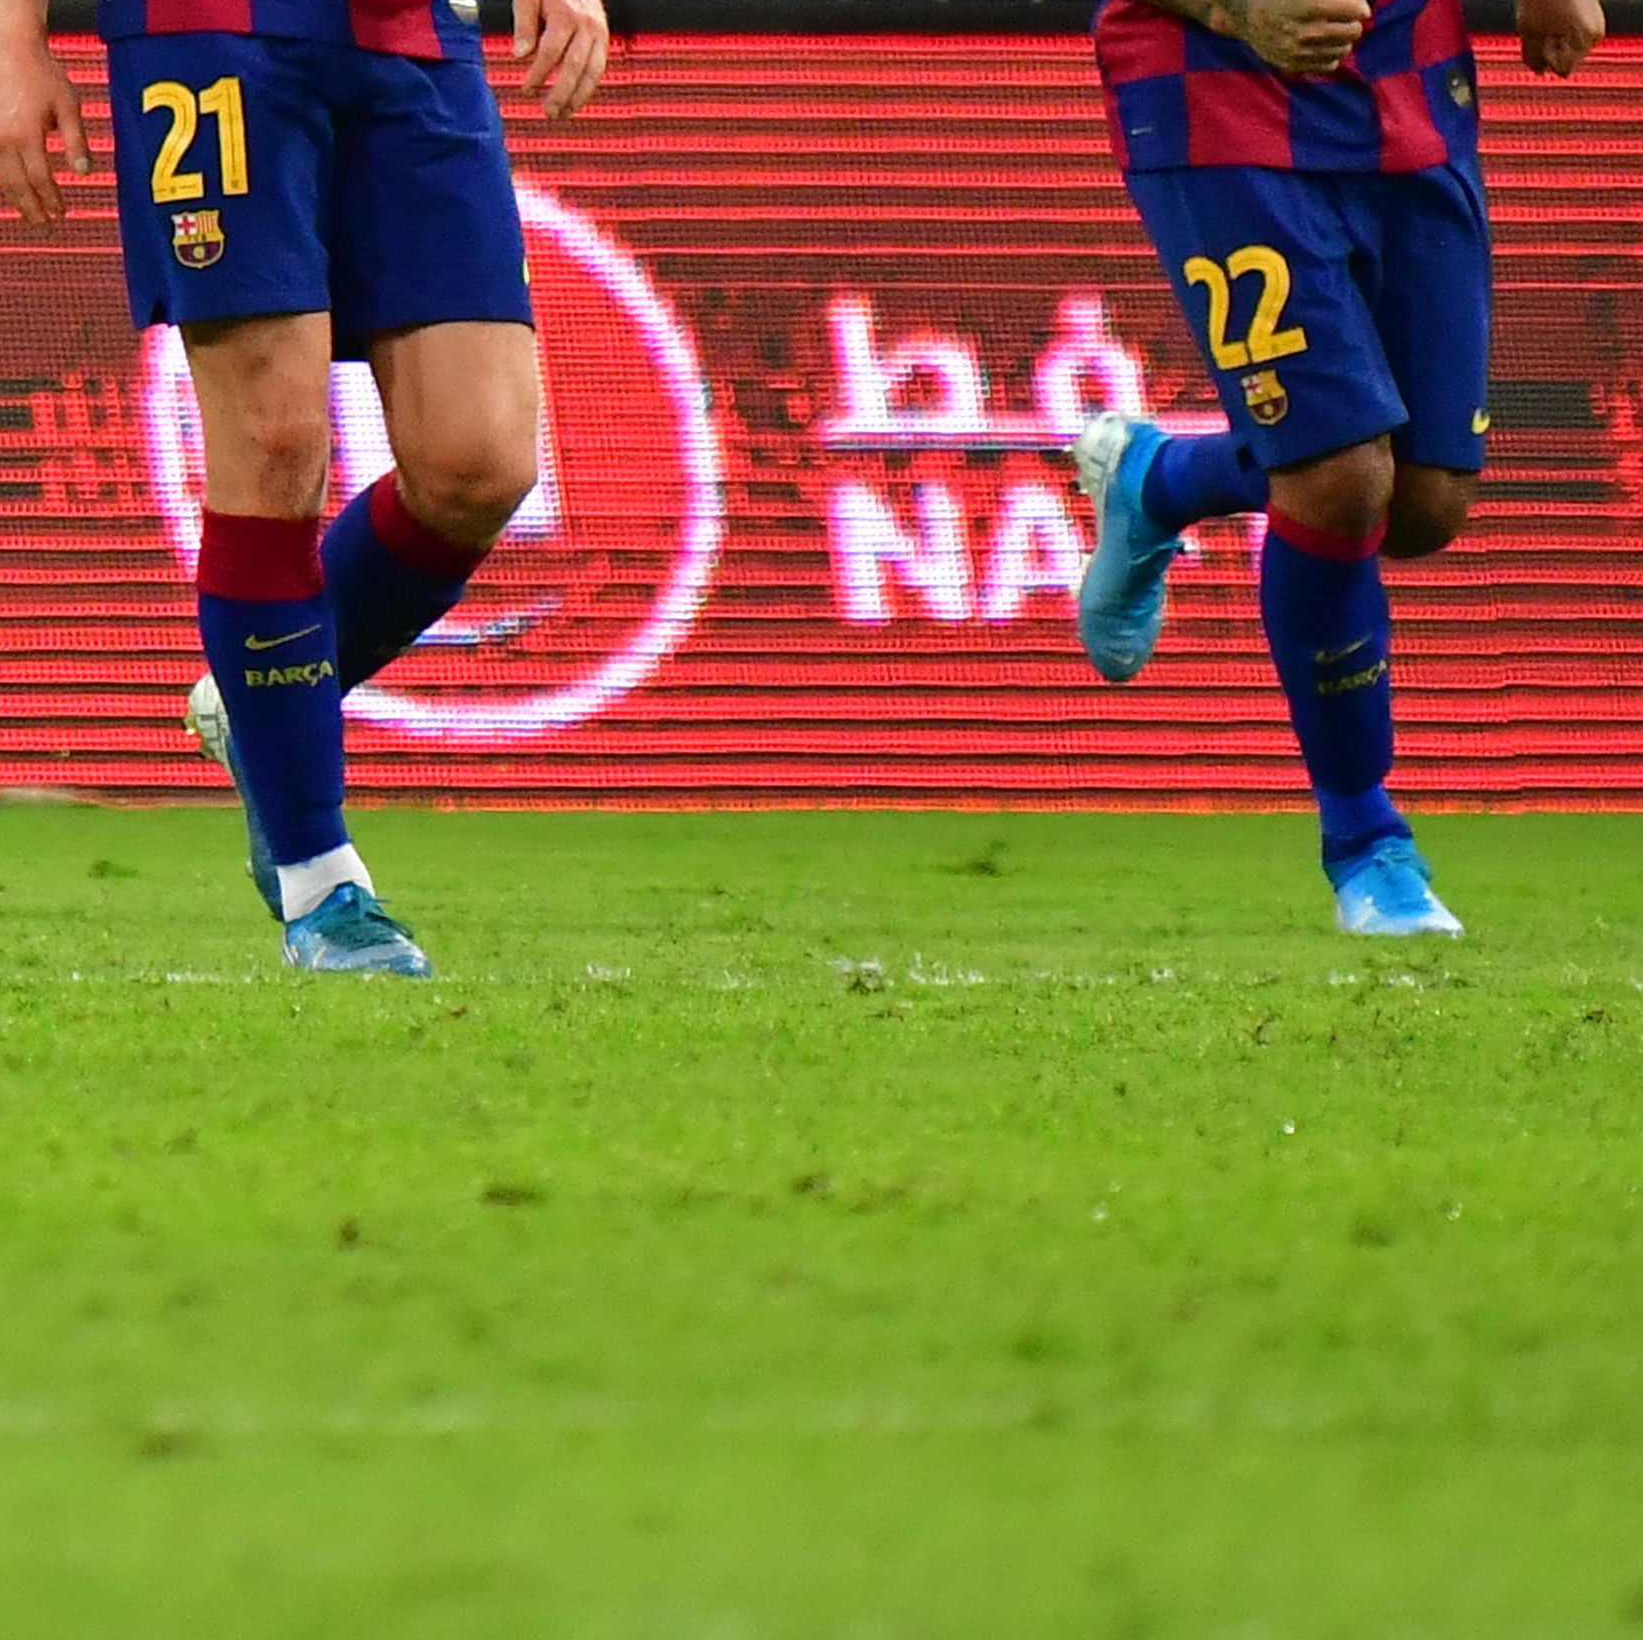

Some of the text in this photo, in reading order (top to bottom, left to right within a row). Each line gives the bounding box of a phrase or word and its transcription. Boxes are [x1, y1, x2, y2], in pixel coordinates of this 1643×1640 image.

[142, 76, 249, 204] 21
[1183, 245, 1308, 370] 22
[244, 659, 335, 688] BARÇA
